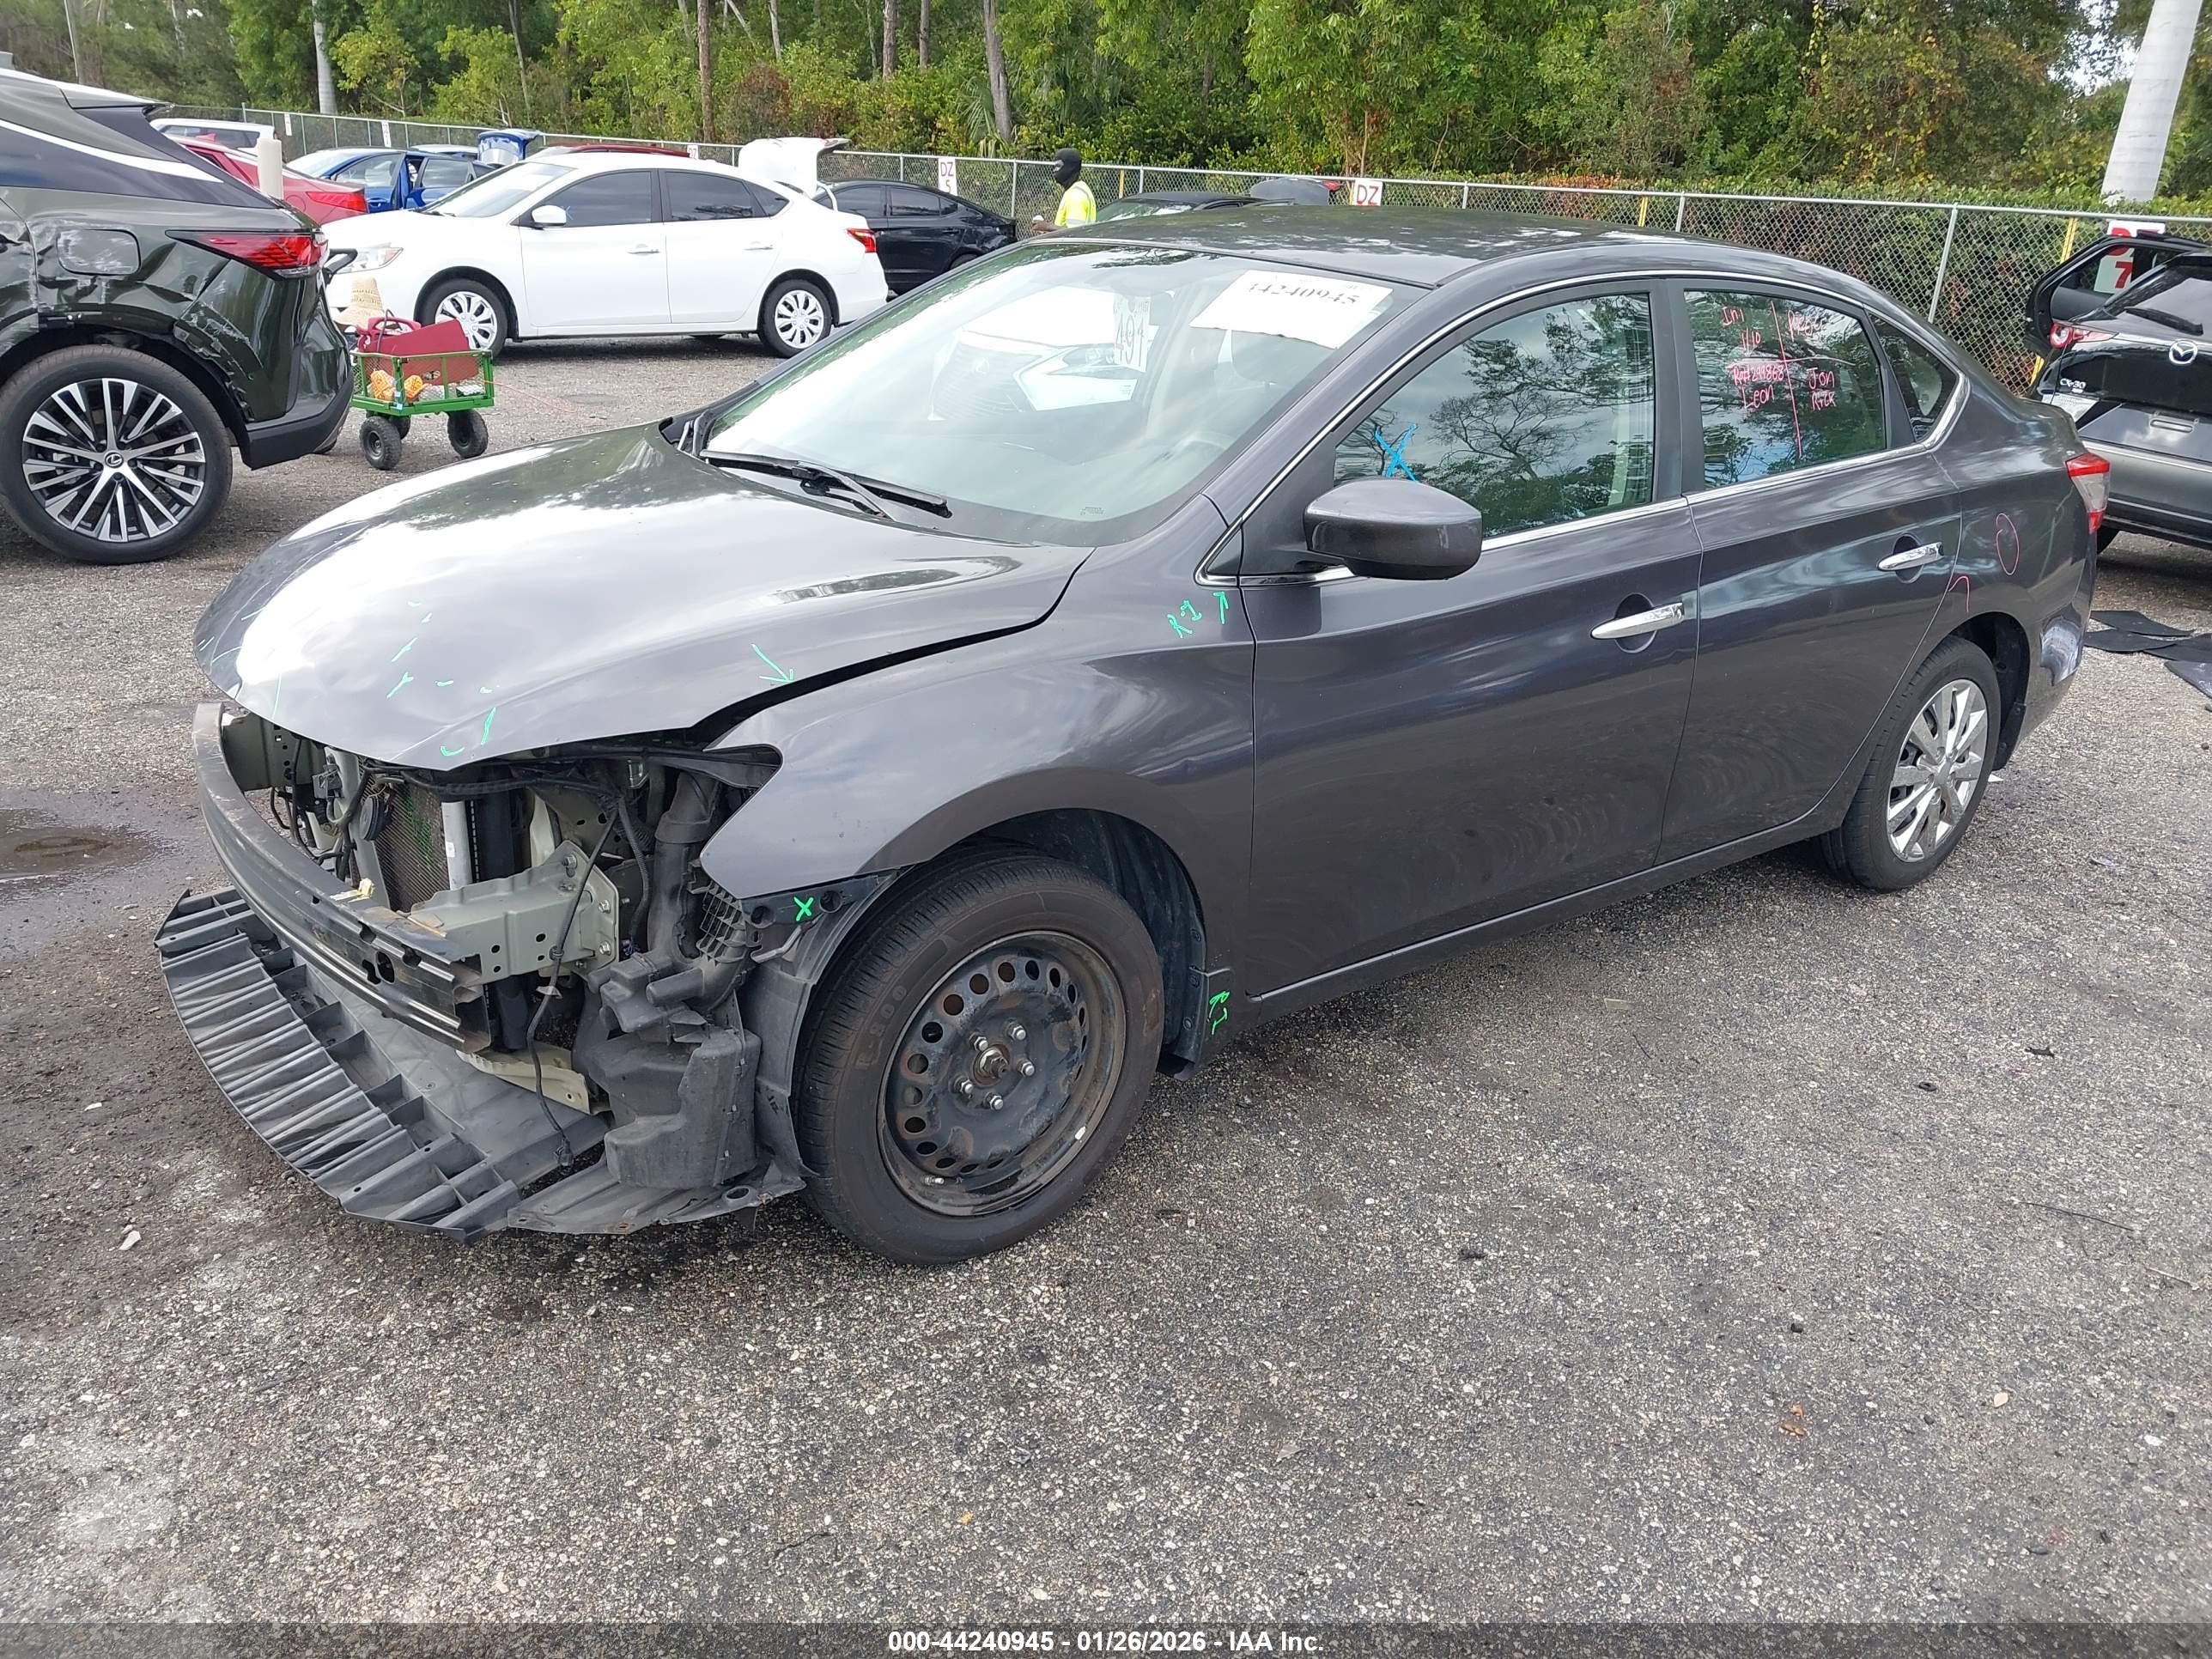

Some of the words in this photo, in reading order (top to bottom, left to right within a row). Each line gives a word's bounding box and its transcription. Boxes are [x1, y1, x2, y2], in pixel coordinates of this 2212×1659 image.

[940, 161, 954, 177] DZ
[1357, 184, 1379, 205] DZ
[2115, 261, 2133, 289] 7
[1806, 367, 1835, 390] Jon
[2059, 378, 2087, 389] CX-30
